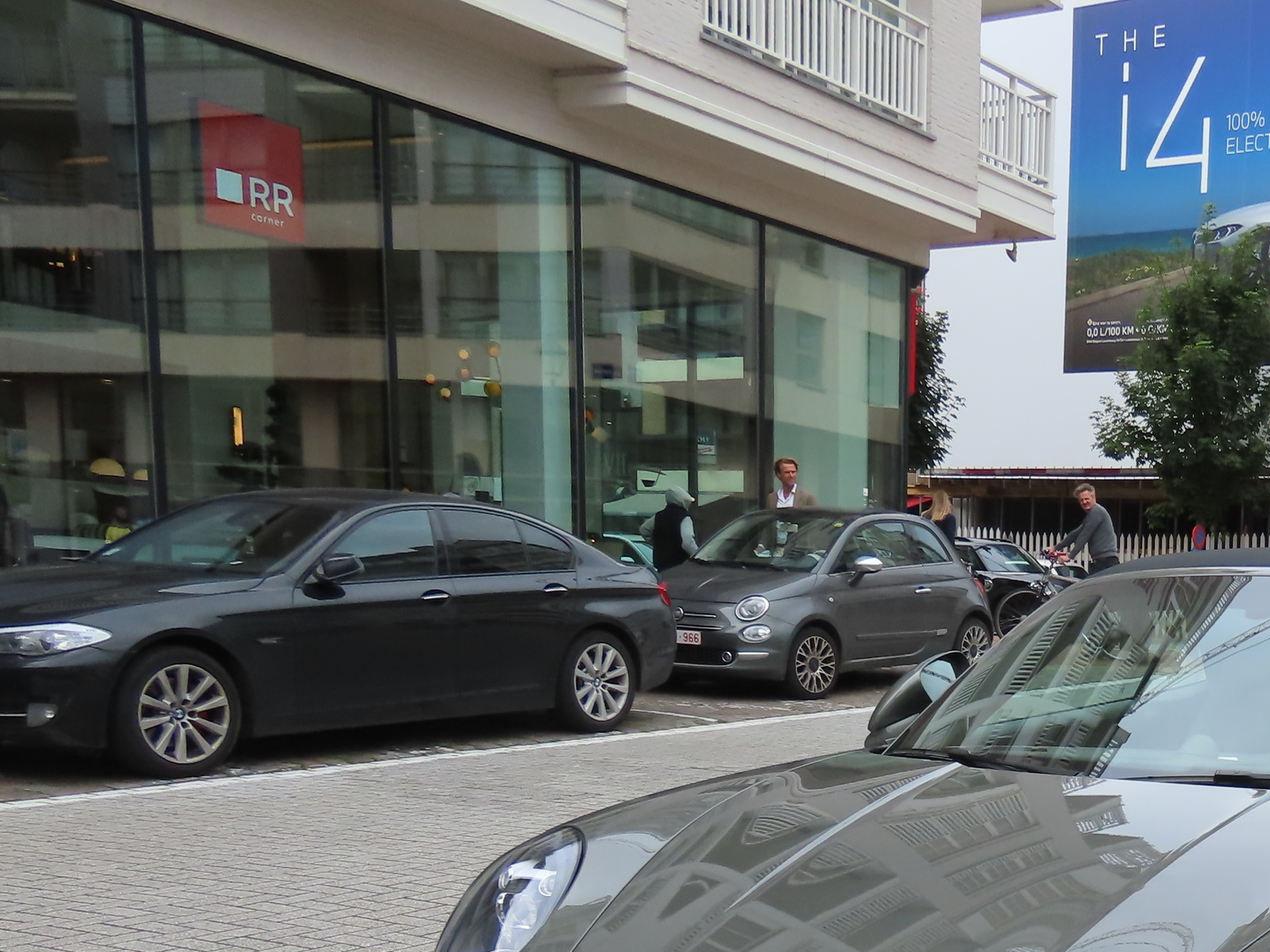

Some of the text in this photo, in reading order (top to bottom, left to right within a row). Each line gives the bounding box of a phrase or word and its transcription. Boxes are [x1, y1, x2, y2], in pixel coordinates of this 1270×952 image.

[1095, 24, 1166, 56] THE
[1120, 56, 1211, 194] i4
[1226, 111, 1266, 131] 100%
[248, 176, 295, 218] RR
[250, 212, 285, 228] corner
[1086, 327, 1099, 338] 0,0
[1100, 326, 1121, 337] L/100
[1122, 325, 1135, 336] KM
